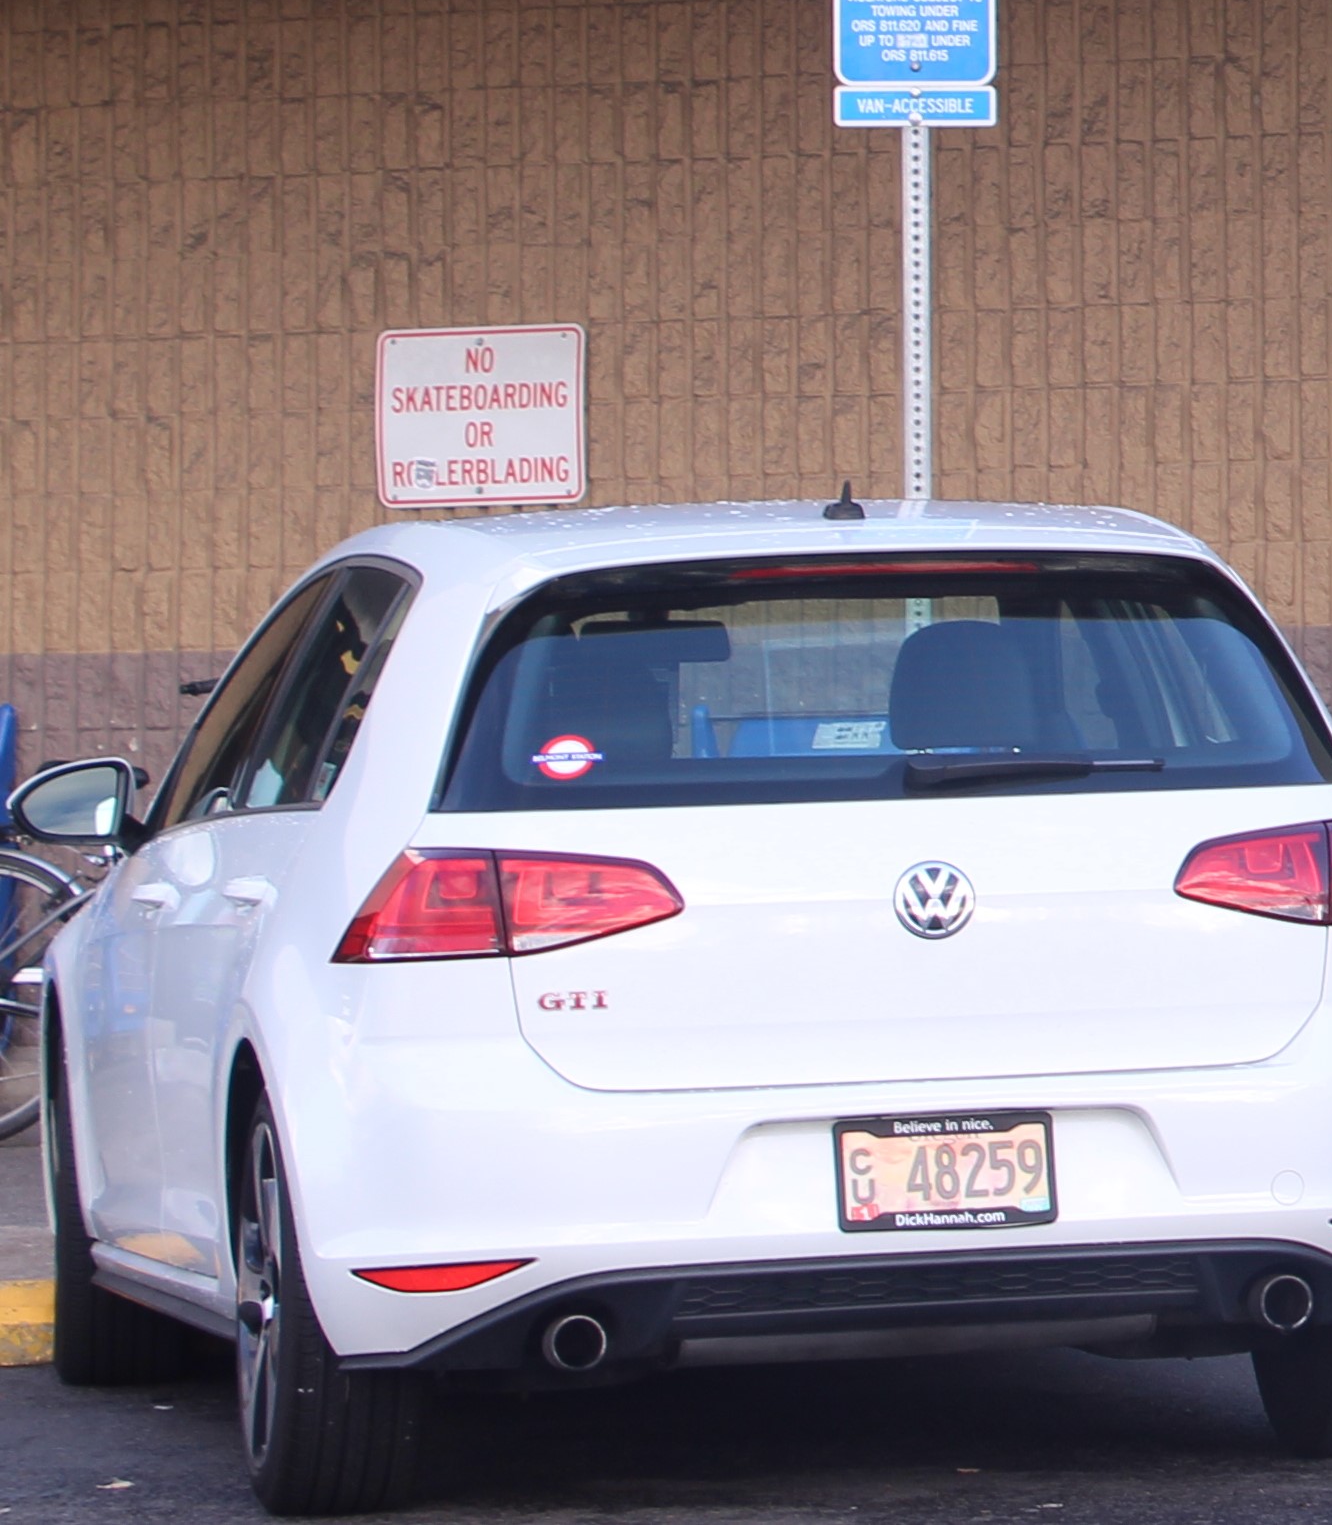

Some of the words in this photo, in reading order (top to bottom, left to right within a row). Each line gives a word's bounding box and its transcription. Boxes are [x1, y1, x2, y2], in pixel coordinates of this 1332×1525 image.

[870, 5, 916, 17] TOWING
[920, 5, 958, 17] UNDER
[851, 20, 876, 32] ORS
[925, 20, 949, 32] AND
[952, 20, 978, 32] FINE
[859, 34, 875, 47] UP
[878, 34, 894, 47] TO
[931, 34, 970, 47] UNDER
[881, 49, 906, 62] ORS
[857, 97, 974, 114] VAN-ACCESSIBLE
[465, 346, 494, 374] NO
[391, 380, 568, 413] SKATEBOARDING
[465, 421, 494, 448] OR
[392, 455, 569, 488] RLERBLADING
[537, 989, 609, 1011] GTI
[893, 1120, 942, 1134] Believe
[945, 1119, 959, 1132] in
[906, 1138, 1044, 1202] 48259
[895, 1211, 1006, 1227] DickHannah.com
